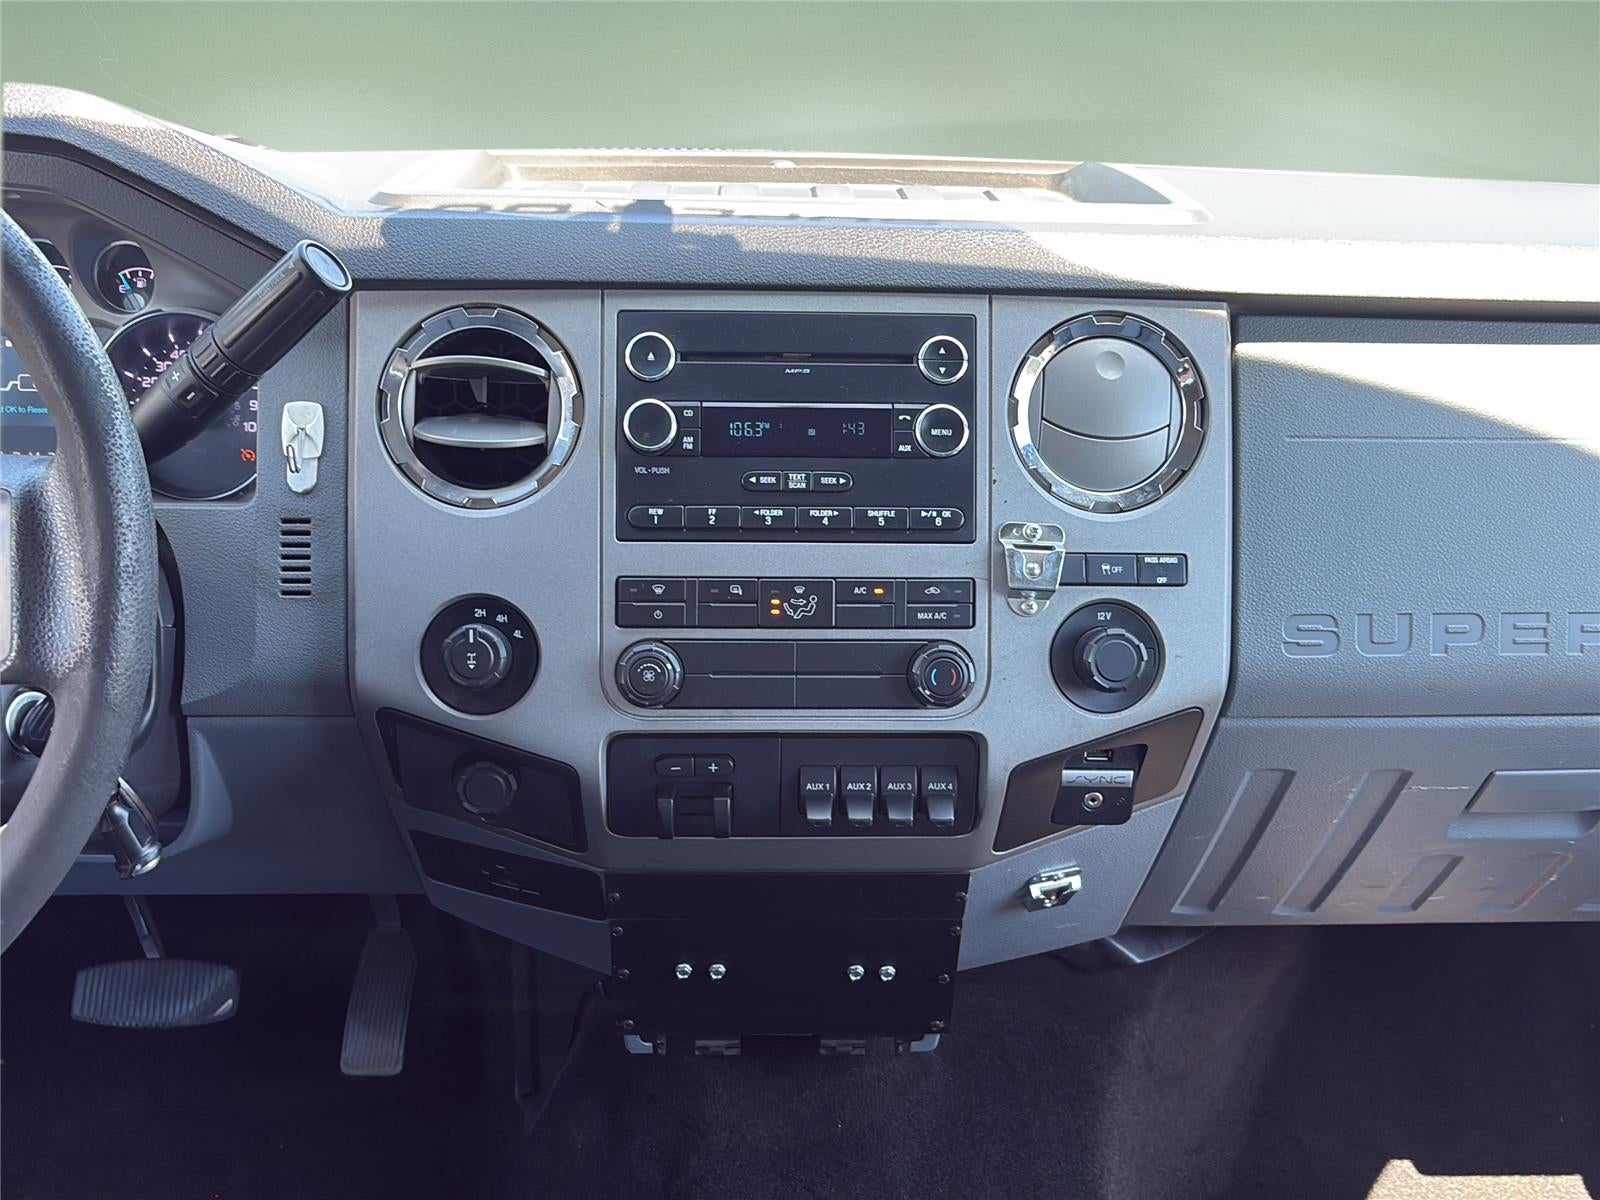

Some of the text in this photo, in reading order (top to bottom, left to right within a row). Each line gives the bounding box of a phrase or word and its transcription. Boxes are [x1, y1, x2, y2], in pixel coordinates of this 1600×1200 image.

[4, 405, 18, 414] OK
[249, 400, 258, 411] 9
[683, 409, 694, 417] CD
[243, 421, 257, 433] 10
[729, 421, 763, 437] 106.3
[930, 428, 953, 437] MENU
[898, 444, 912, 452] AUX
[759, 476, 777, 484] SEEK
[820, 477, 837, 485] SEEK
[787, 481, 806, 489] SCAN
[941, 510, 952, 518] OK
[653, 515, 658, 525] 1
[708, 515, 716, 525] 2
[764, 516, 772, 526] 3
[821, 517, 829, 526] 4
[878, 517, 885, 527] 5
[935, 517, 942, 527] 6
[1111, 566, 1123, 574] OFF
[1156, 576, 1168, 584] OFF
[853, 586, 867, 594] A/C
[474, 608, 487, 618] 2H
[917, 612, 948, 620] MAX A/C
[495, 613, 508, 623] 4H
[512, 629, 525, 639] 4L
[1066, 775, 1127, 785] SYNC
[806, 782, 830, 790] AUX 1
[846, 782, 872, 790] AUX 2
[887, 782, 912, 790] AUX 3
[927, 782, 953, 790] AUX 4
